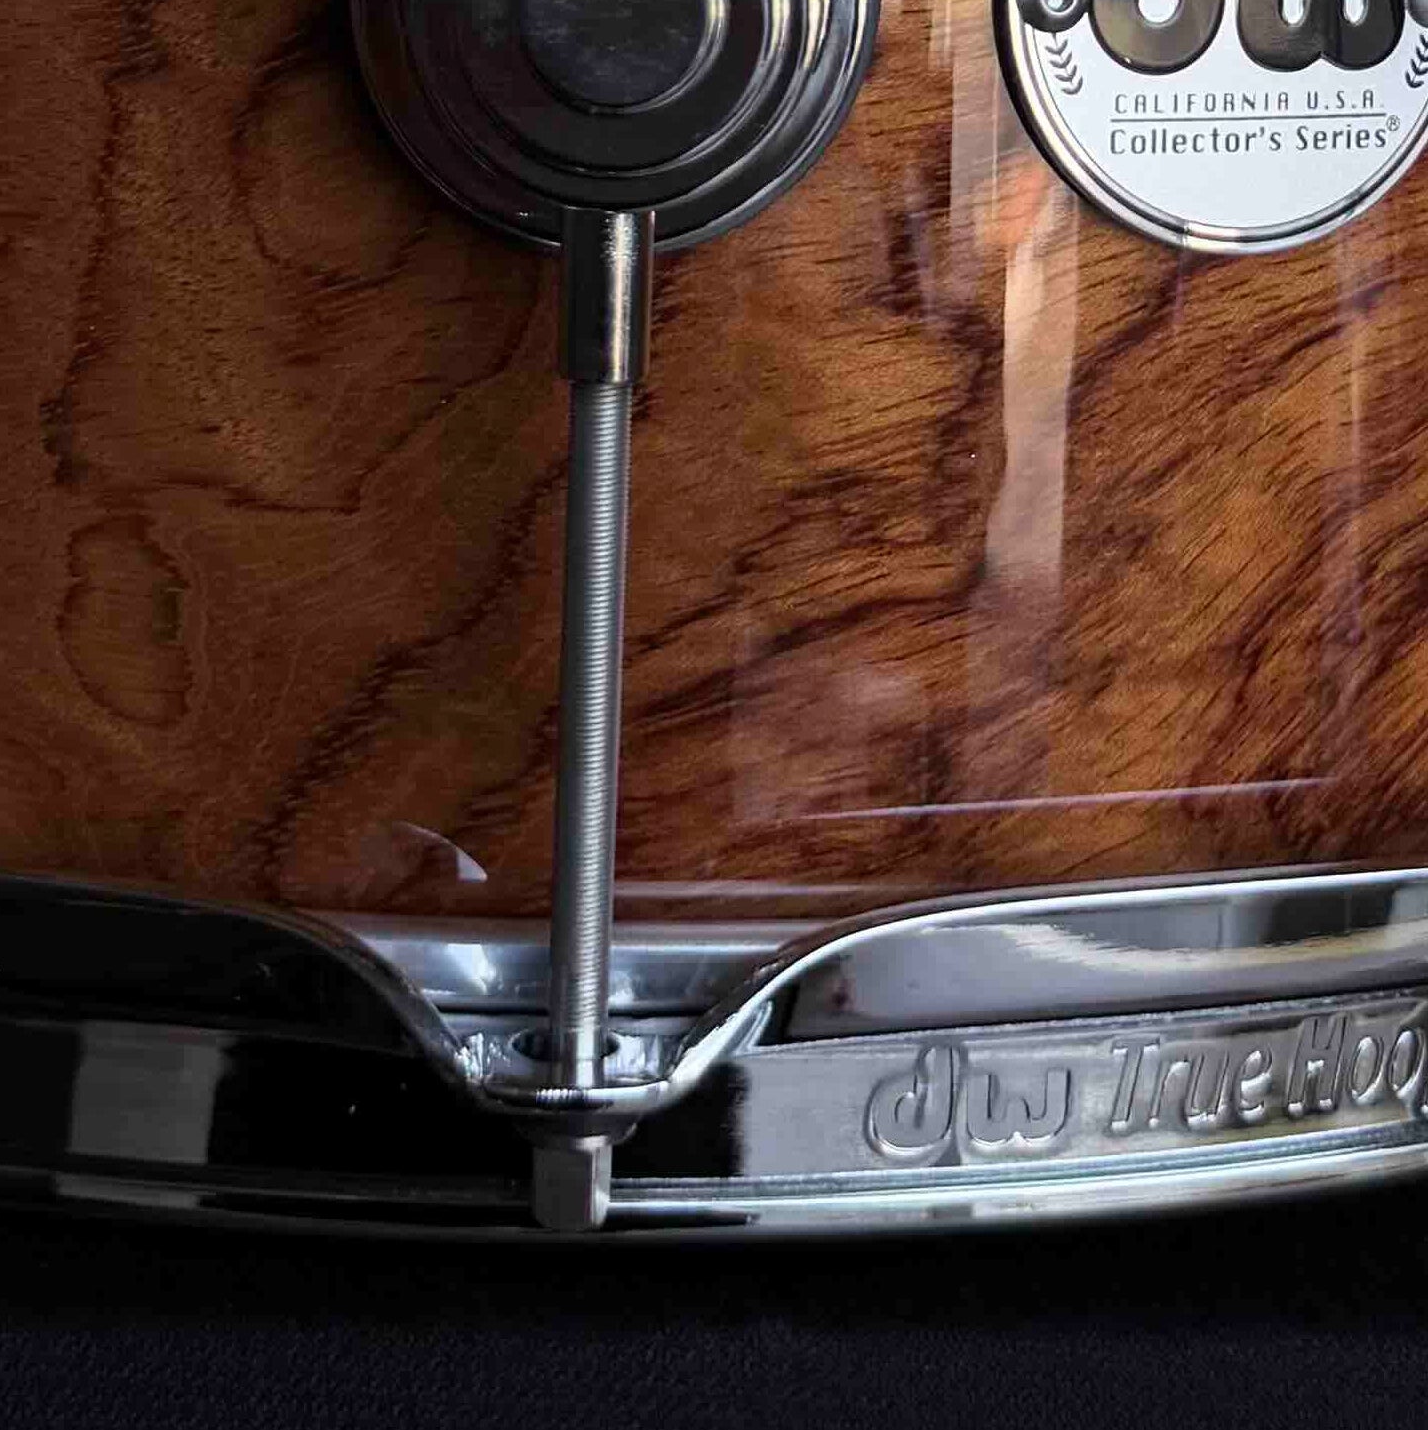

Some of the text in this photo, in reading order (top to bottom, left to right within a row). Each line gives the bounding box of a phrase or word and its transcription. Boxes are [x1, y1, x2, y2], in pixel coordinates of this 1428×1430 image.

[1113, 91, 1290, 115] CALIFORNIA
[1109, 126, 1282, 155] Collector's
[865, 1044, 1070, 1157] dw
